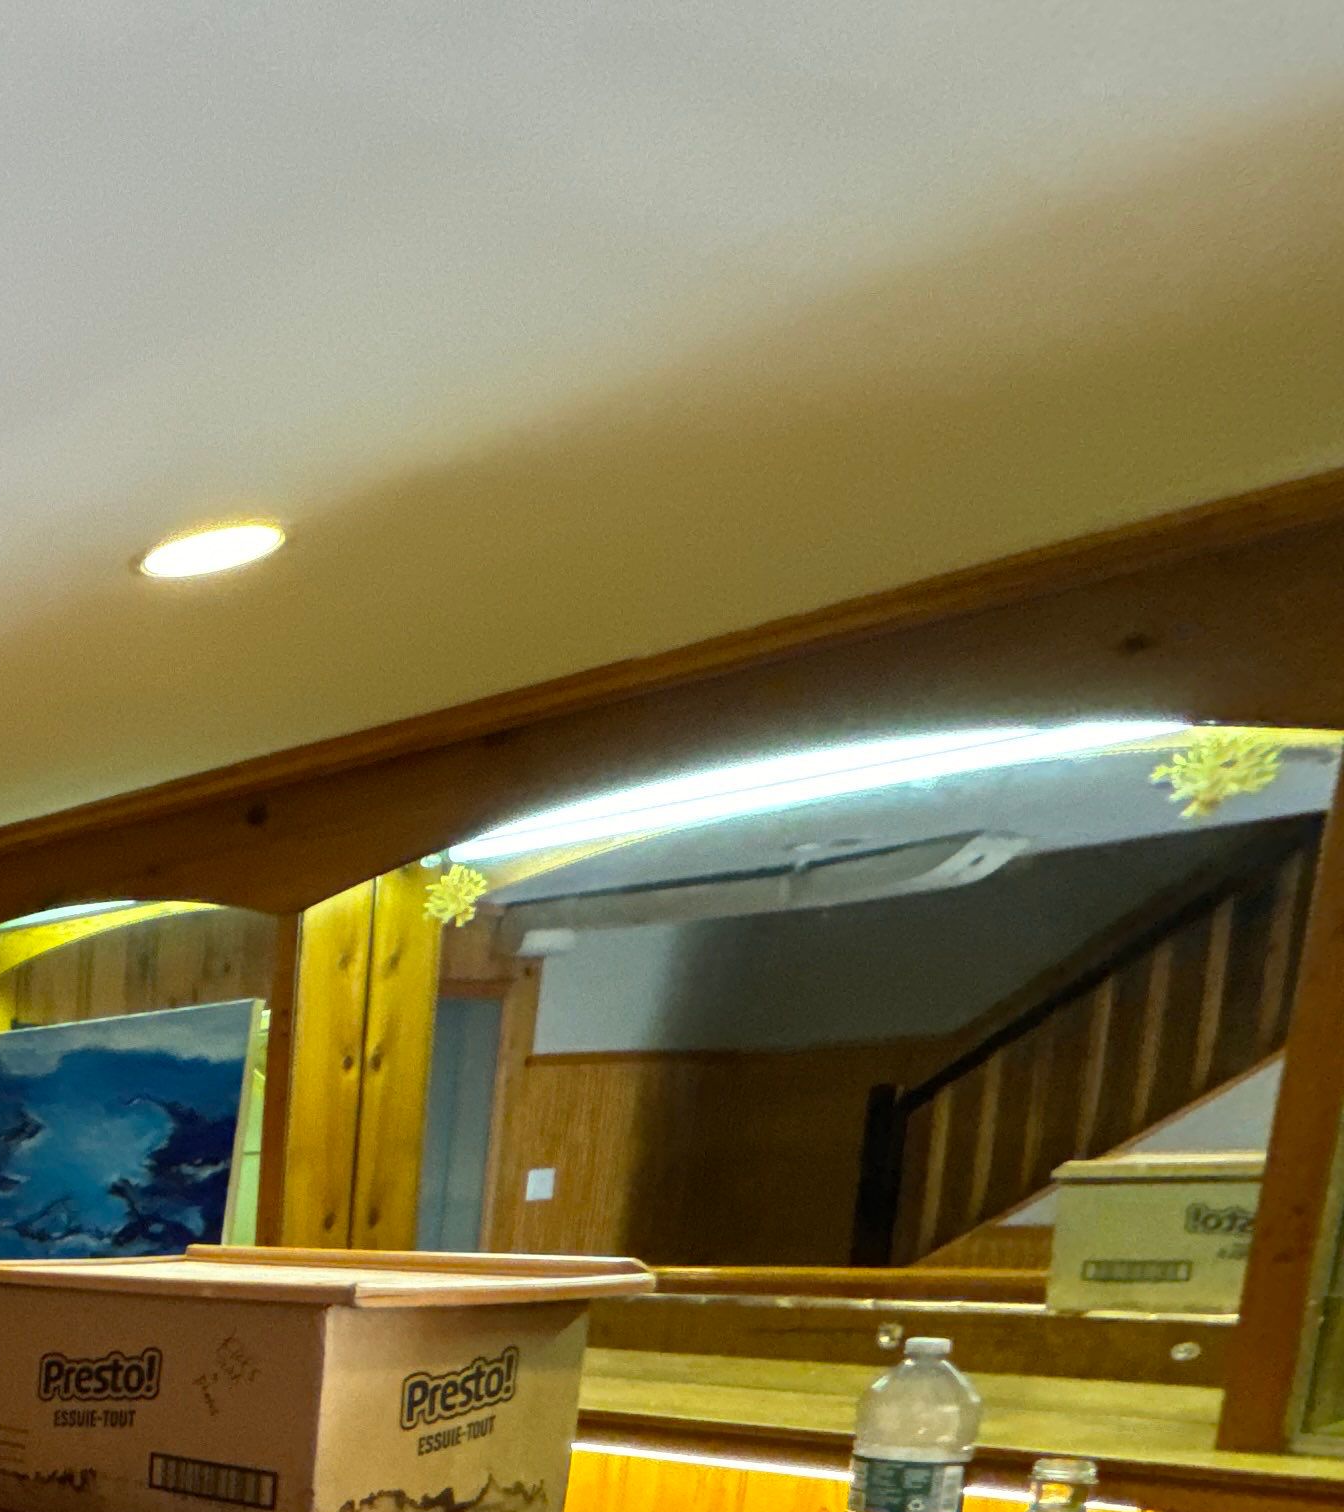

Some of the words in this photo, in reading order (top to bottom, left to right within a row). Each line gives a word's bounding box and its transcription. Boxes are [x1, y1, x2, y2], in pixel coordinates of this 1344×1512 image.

[42, 1354, 157, 1394] Presto!
[406, 1353, 515, 1422] Presto!
[53, 1409, 137, 1428] ESSUIE-TOUT
[416, 1415, 497, 1457] ESSUIE-TOUT
